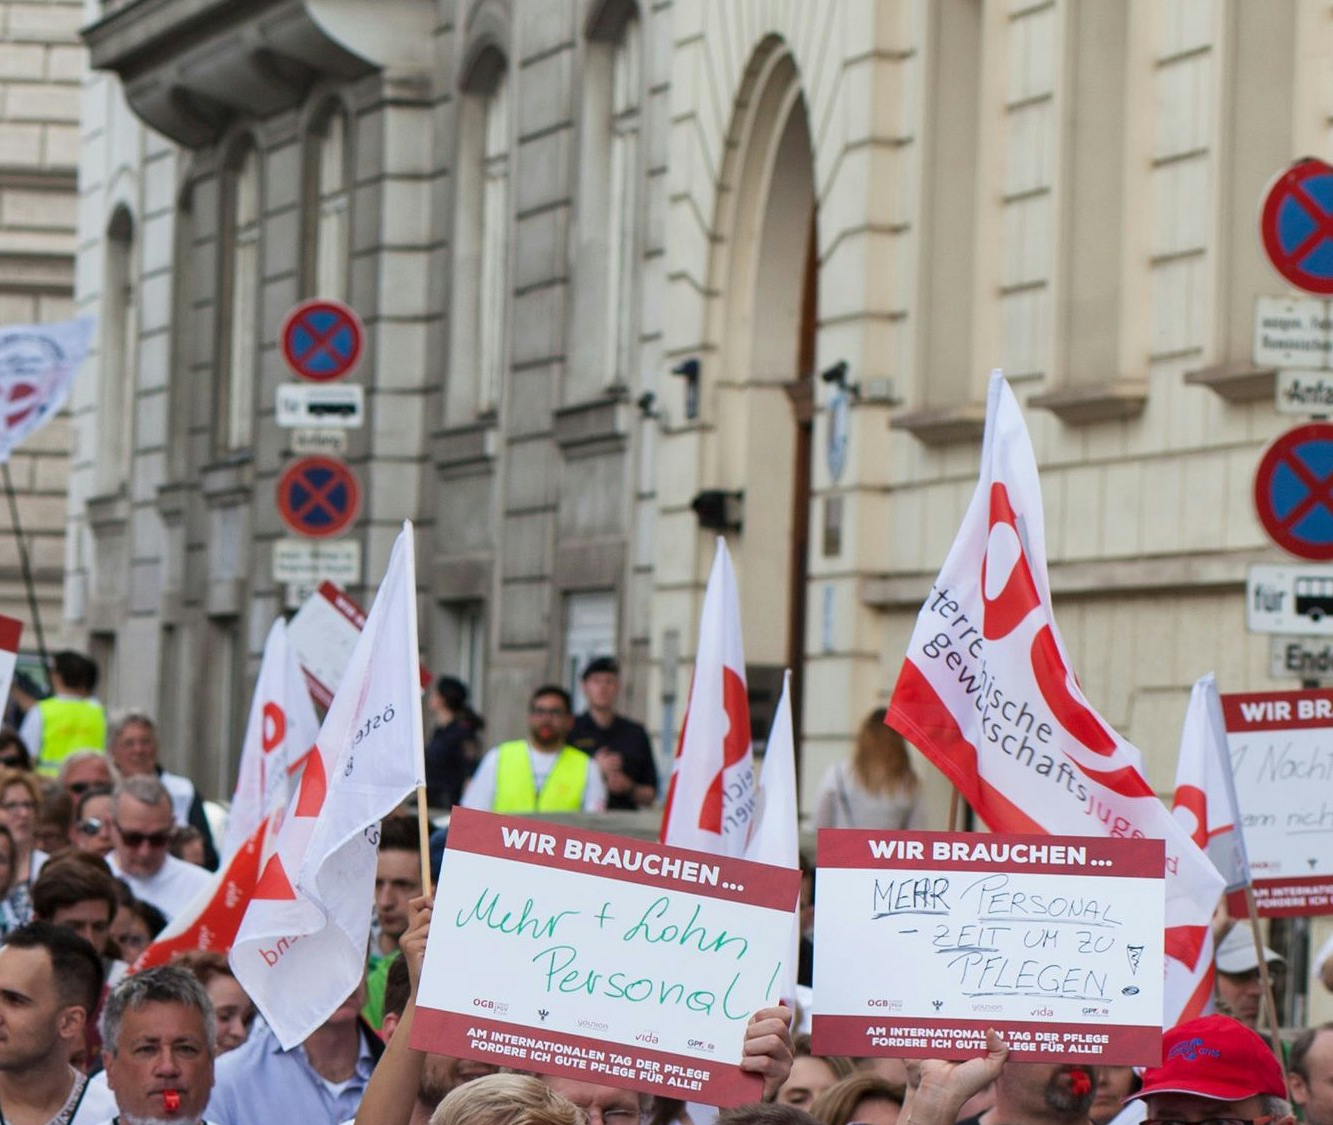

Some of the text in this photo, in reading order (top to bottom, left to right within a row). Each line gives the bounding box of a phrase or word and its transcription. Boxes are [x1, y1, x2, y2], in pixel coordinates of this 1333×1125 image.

[1240, 701, 1291, 722] WIR
[500, 826, 557, 856] WIR
[869, 840, 924, 860] WIR
[960, 873, 1123, 922] PERSONAL
[455, 887, 748, 960] Mehr + Lohn
[932, 925, 1115, 954] ZEIT UM ZU
[947, 951, 1108, 997] PFLEGEN
[467, 1027, 710, 1081] AM INTERNATIONALEN TAG DER PFLEGE
[635, 1032, 659, 1045] vida
[471, 1039, 702, 1091] FORDERE ICH GUTE PFLEGE FÜR ALLE!
